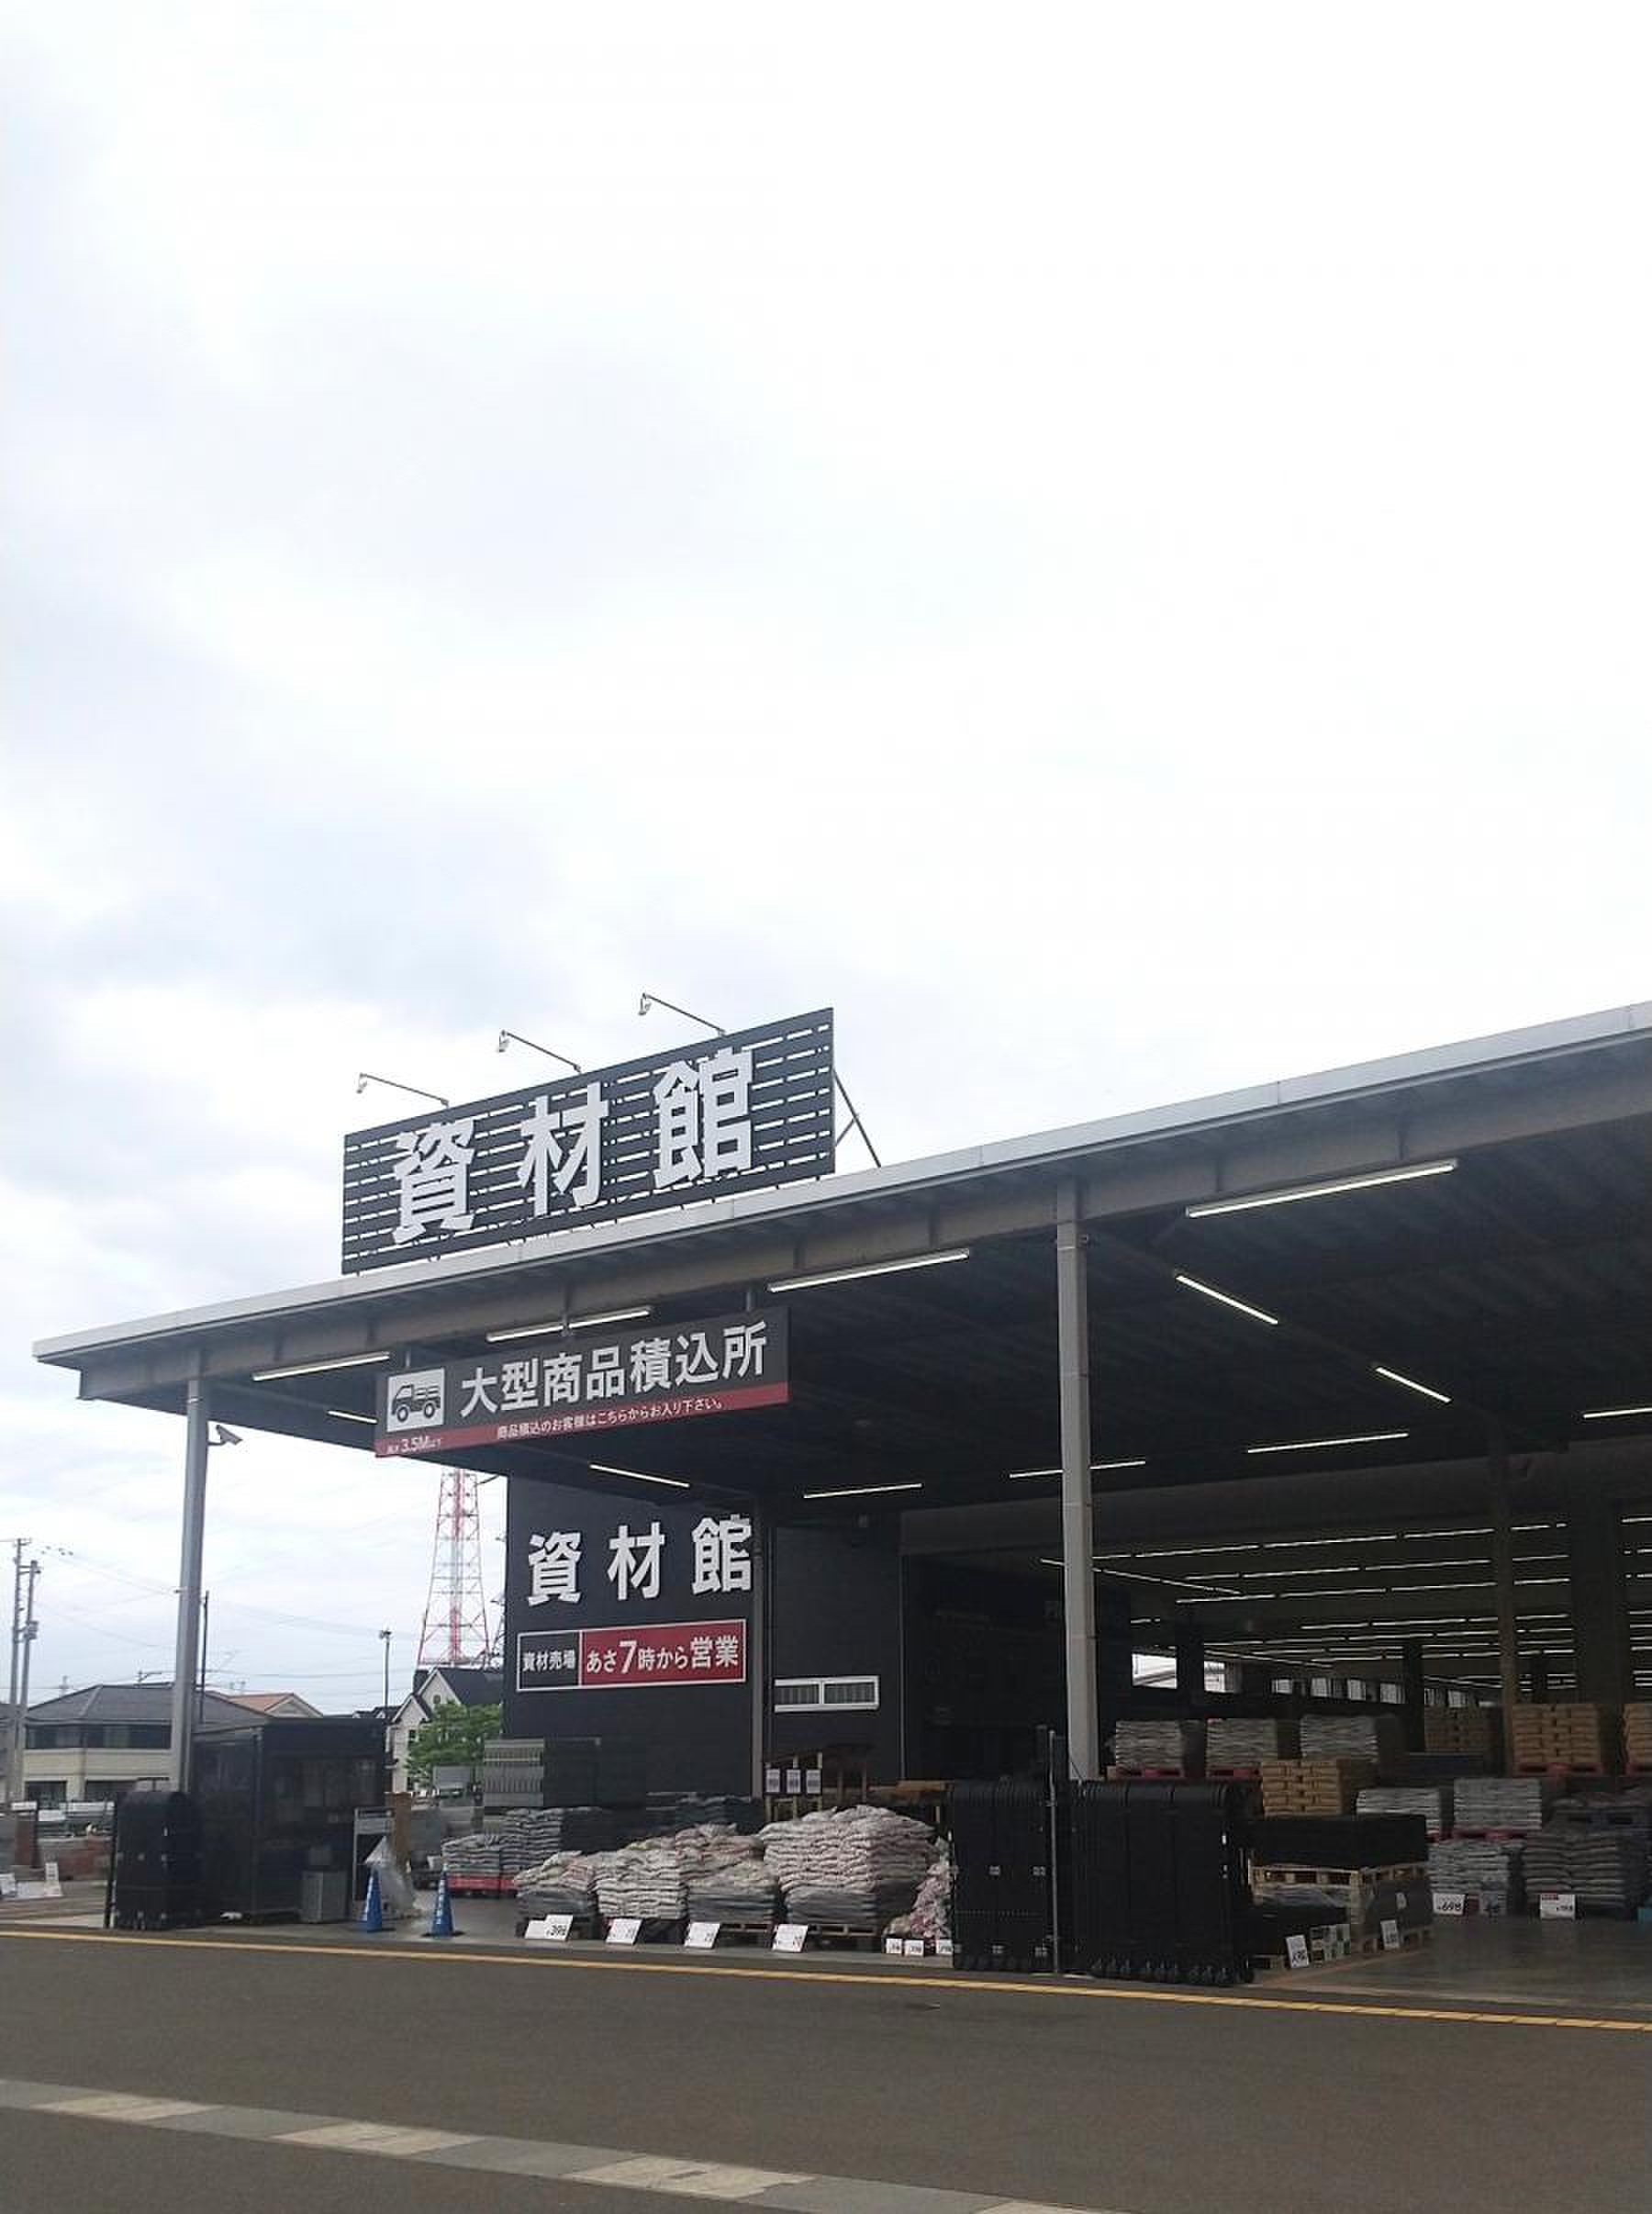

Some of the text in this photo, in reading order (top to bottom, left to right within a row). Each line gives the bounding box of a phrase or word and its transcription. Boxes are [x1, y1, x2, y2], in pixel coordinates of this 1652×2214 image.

[391, 1046, 753, 1246] 資材館
[459, 1319, 768, 1418] 大型商品積込所
[528, 1513, 753, 1606] 資材館
[522, 1649, 576, 1672] 資材売場
[586, 1635, 740, 1674] あさ7時から営業
